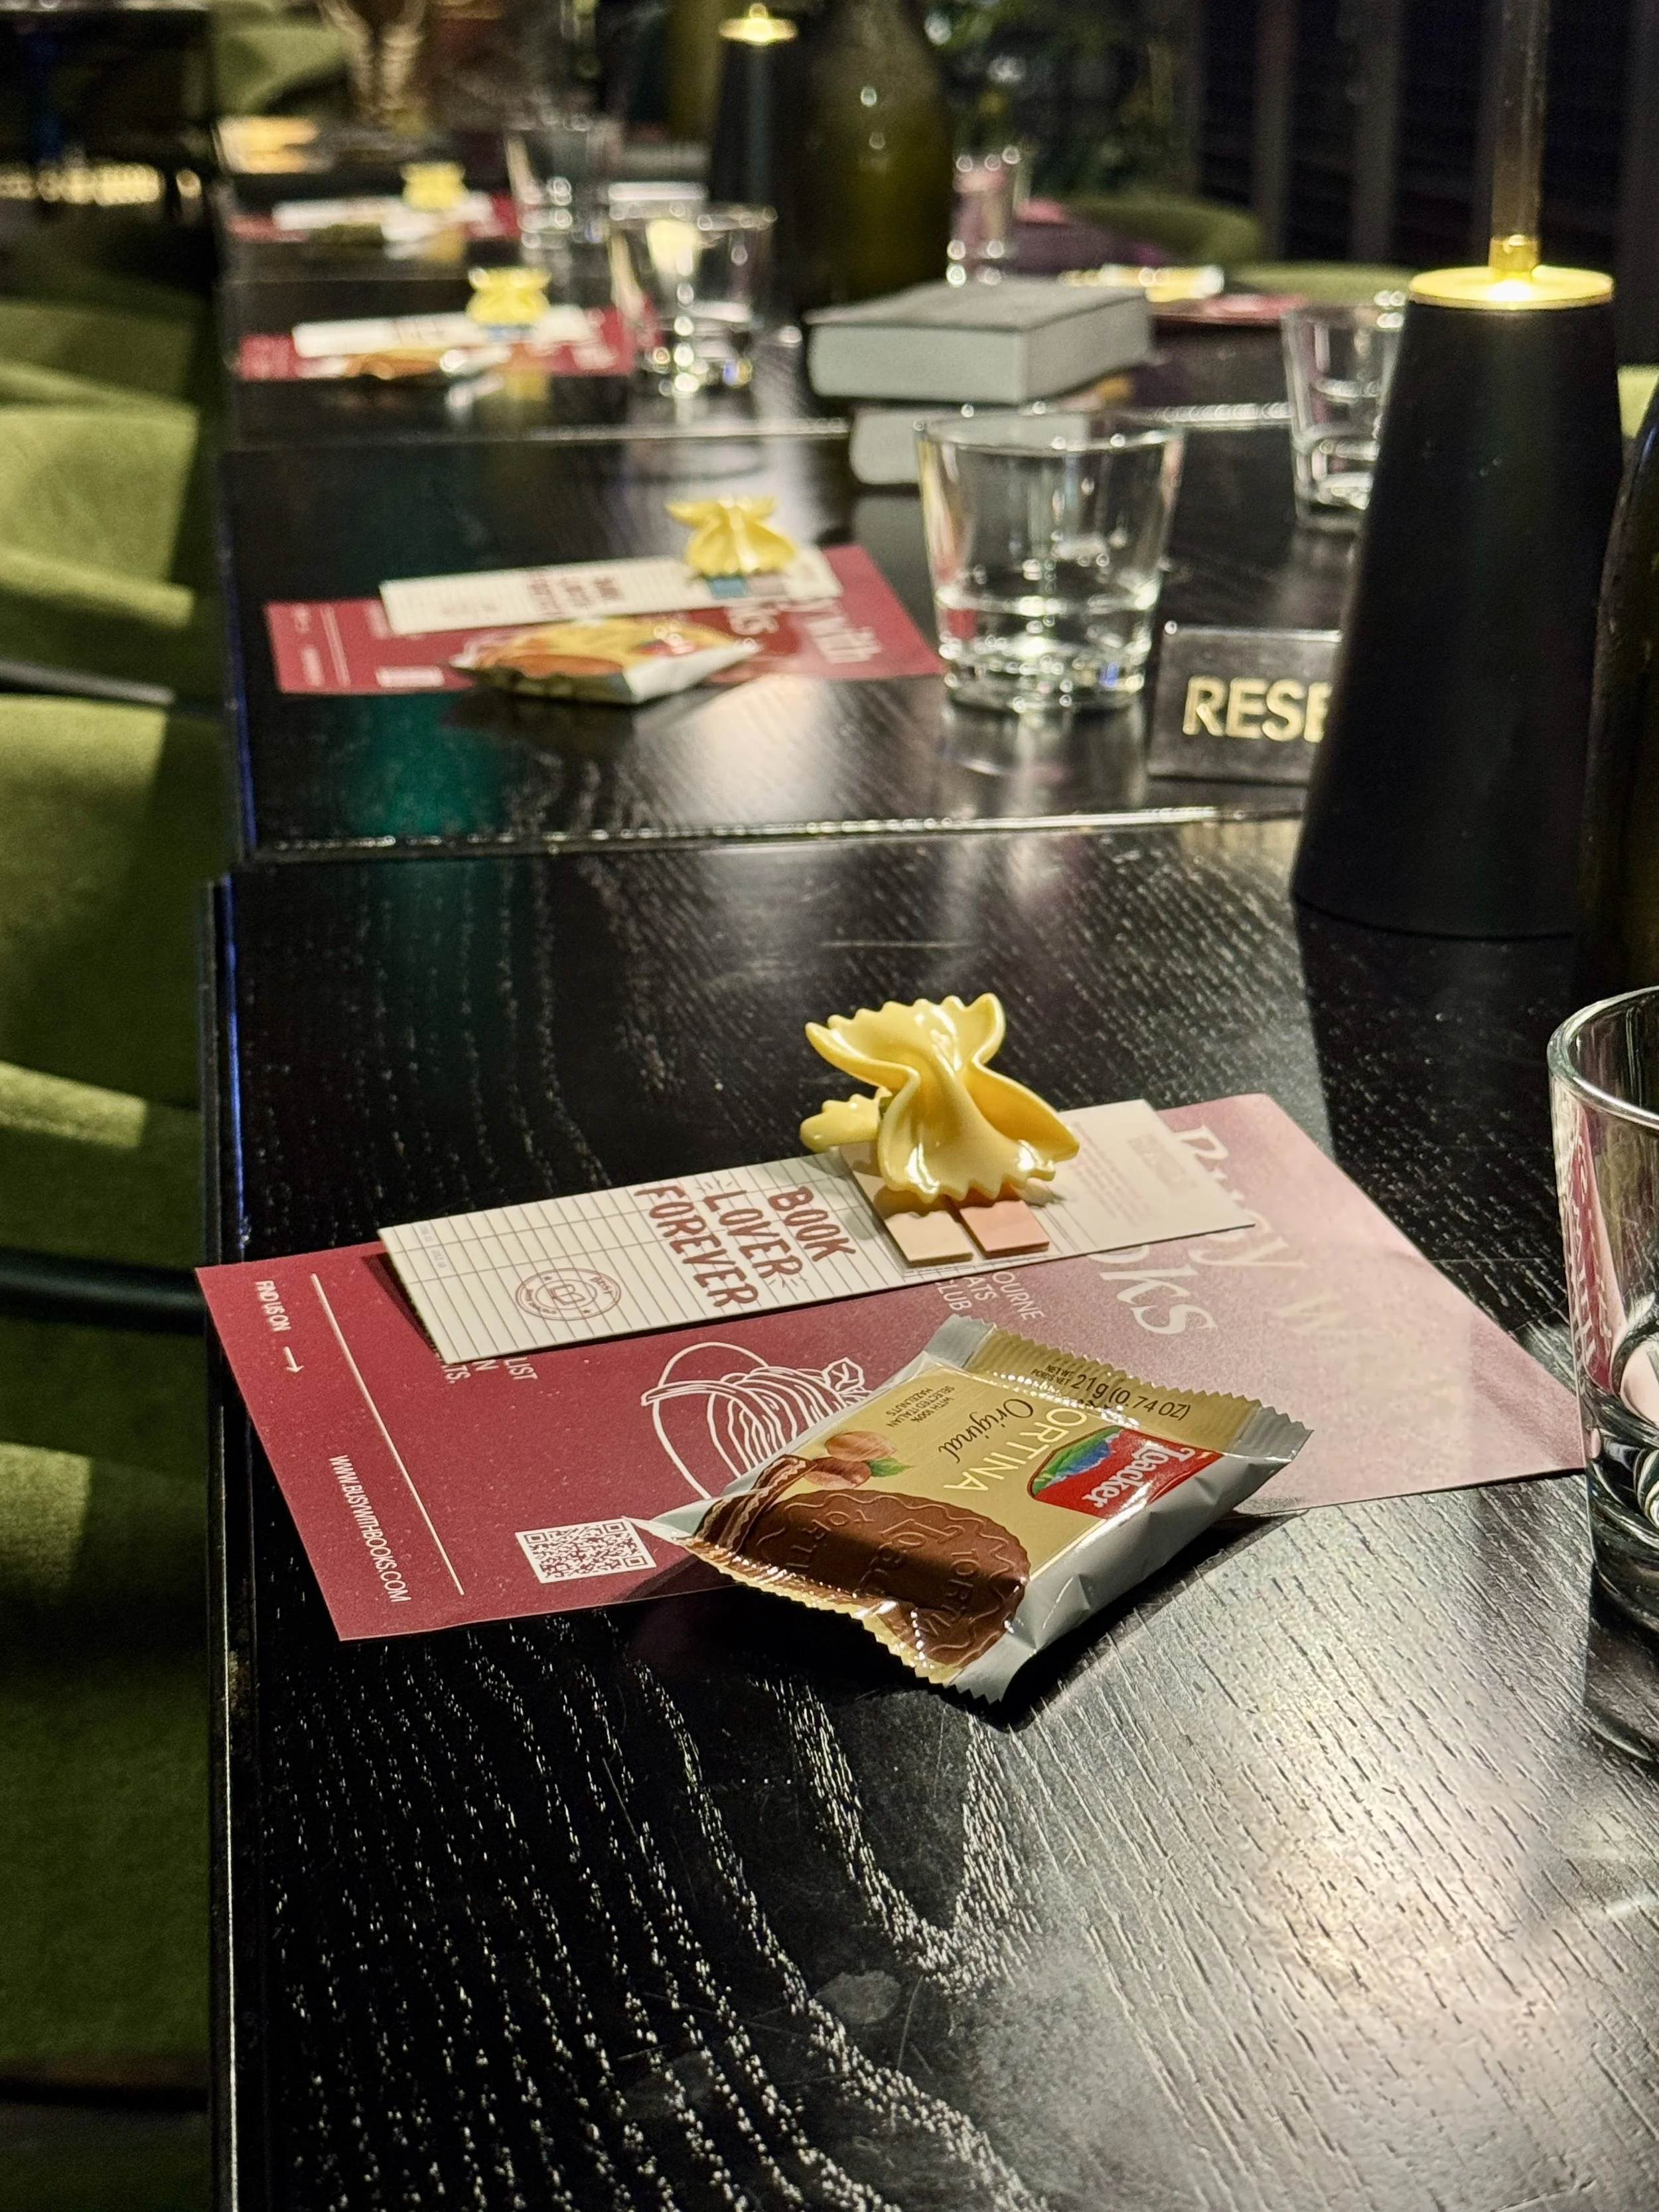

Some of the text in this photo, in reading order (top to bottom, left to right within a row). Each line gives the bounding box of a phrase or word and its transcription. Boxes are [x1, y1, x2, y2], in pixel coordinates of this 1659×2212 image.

[634, 1185, 758, 1307] FOREVER
[703, 1189, 803, 1280] LOVER
[768, 1186, 857, 1262] BOOK
[255, 1280, 279, 1301] FIND
[269, 1314, 291, 1332] ON
[1031, 1368, 1054, 1382] POIDS
[1045, 1365, 1062, 1376] NET
[1070, 1374, 1109, 1399] 21g
[1158, 1402, 1191, 1421] OZ)
[885, 1388, 933, 1416] HAZELNUTS
[886, 1385, 955, 1428] SELECTED ITALIAN
[910, 1396, 955, 1422] WITH 100%
[938, 1398, 1035, 1463] Original
[944, 1407, 1088, 1493] ORTINA
[1082, 1445, 1196, 1509] Loacker
[330, 1455, 411, 1602] WWW.BUSYWITHBOOKS.COM
